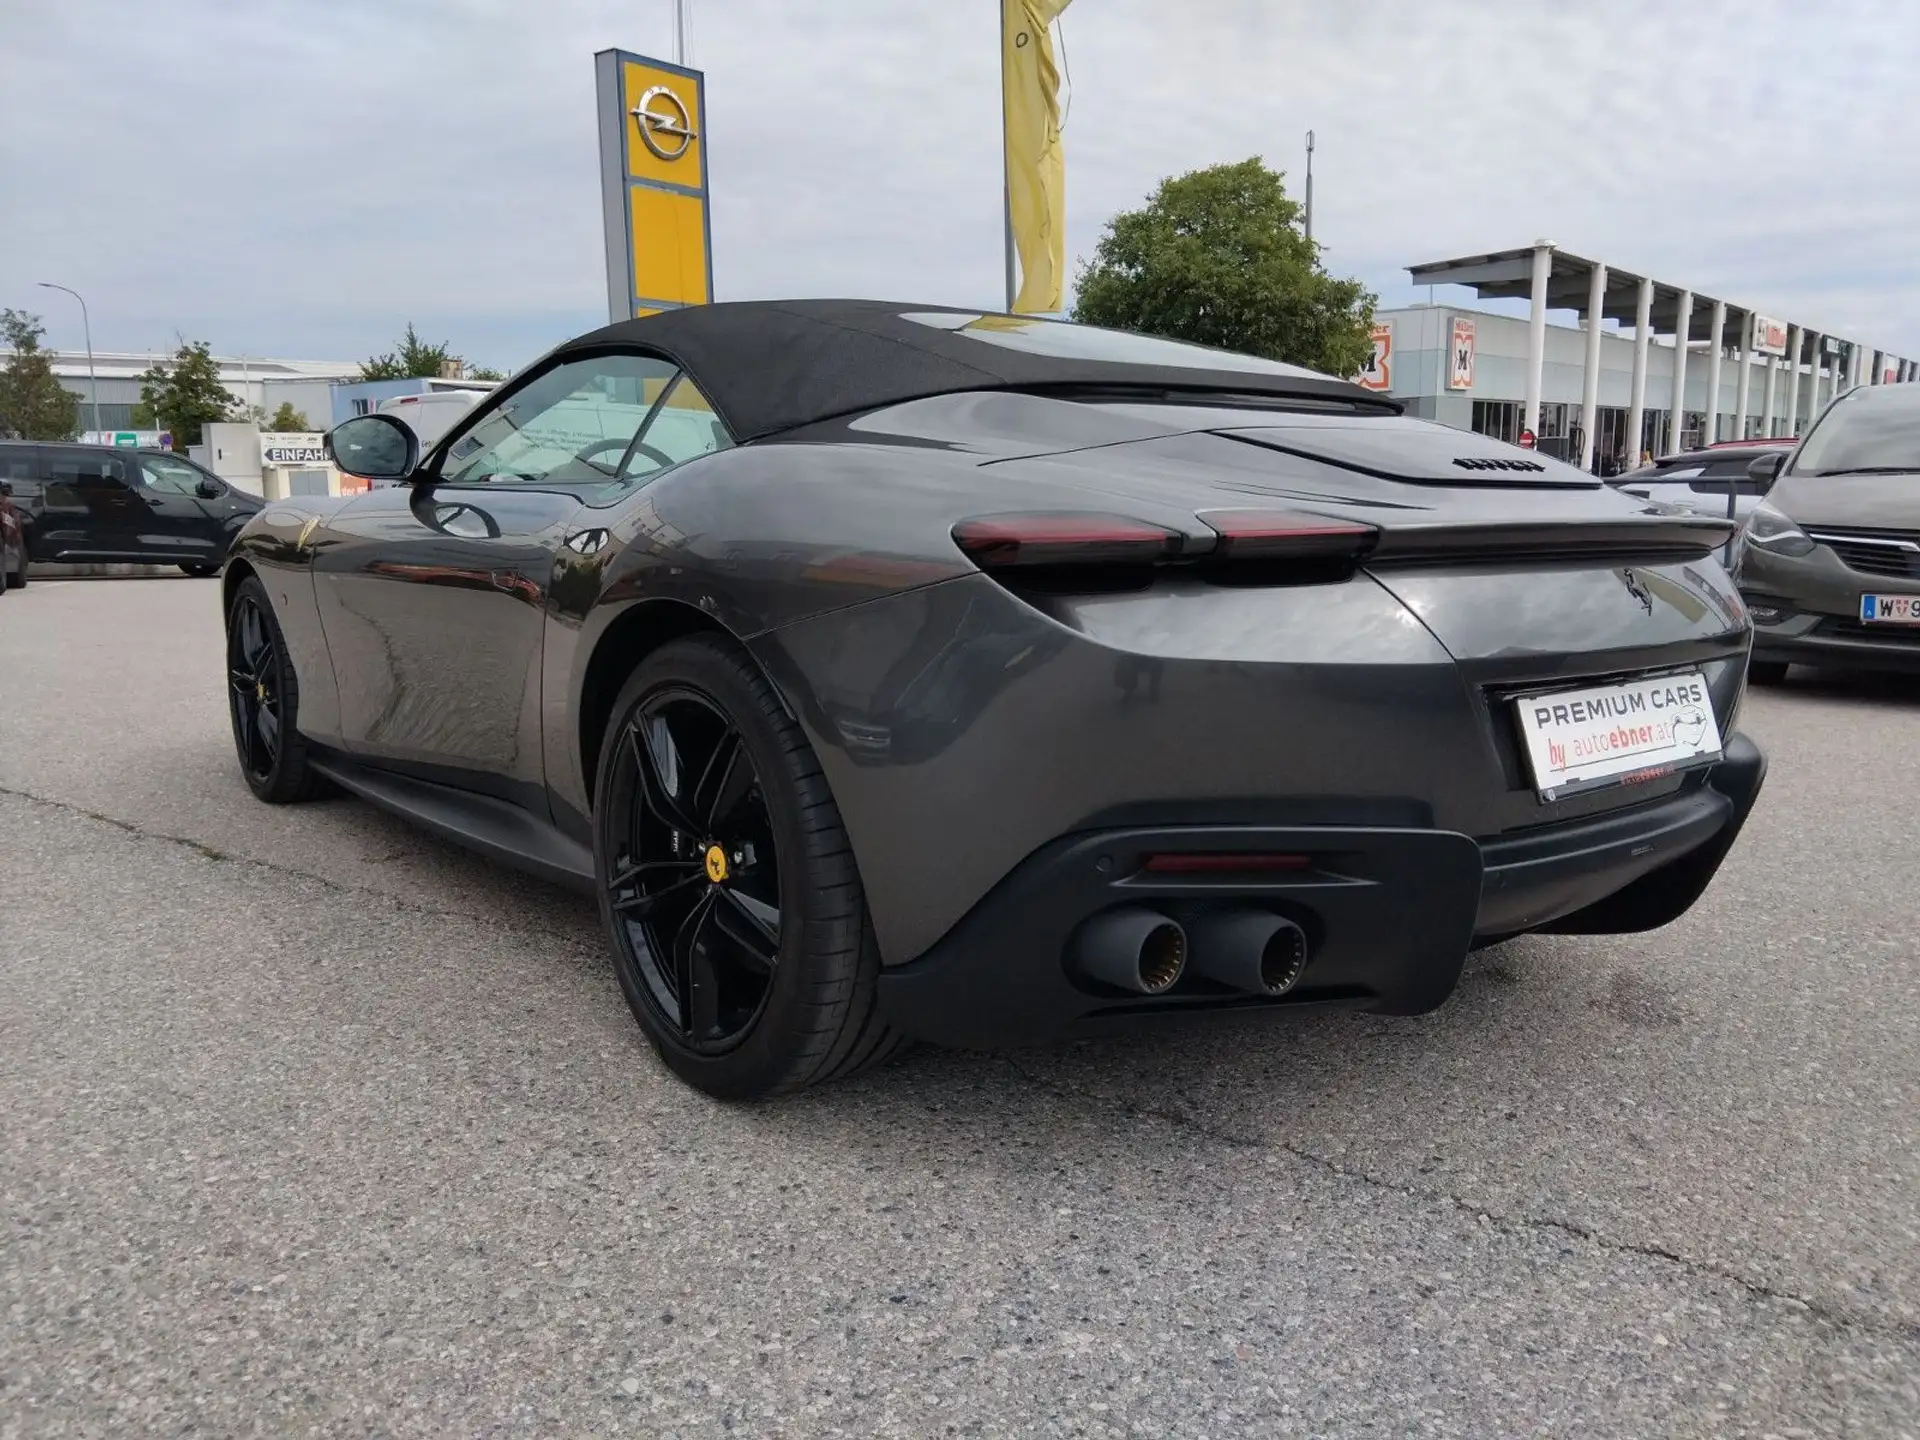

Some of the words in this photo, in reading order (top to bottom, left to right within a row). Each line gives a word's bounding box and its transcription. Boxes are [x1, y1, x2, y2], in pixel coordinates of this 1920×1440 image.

[1458, 349, 1468, 371] M
[1880, 599, 1894, 617] W
[1534, 692, 1647, 729] PREMIUM
[1650, 684, 1702, 709] CARS
[1548, 738, 1566, 771] by
[1573, 721, 1674, 757] autoebner.at
